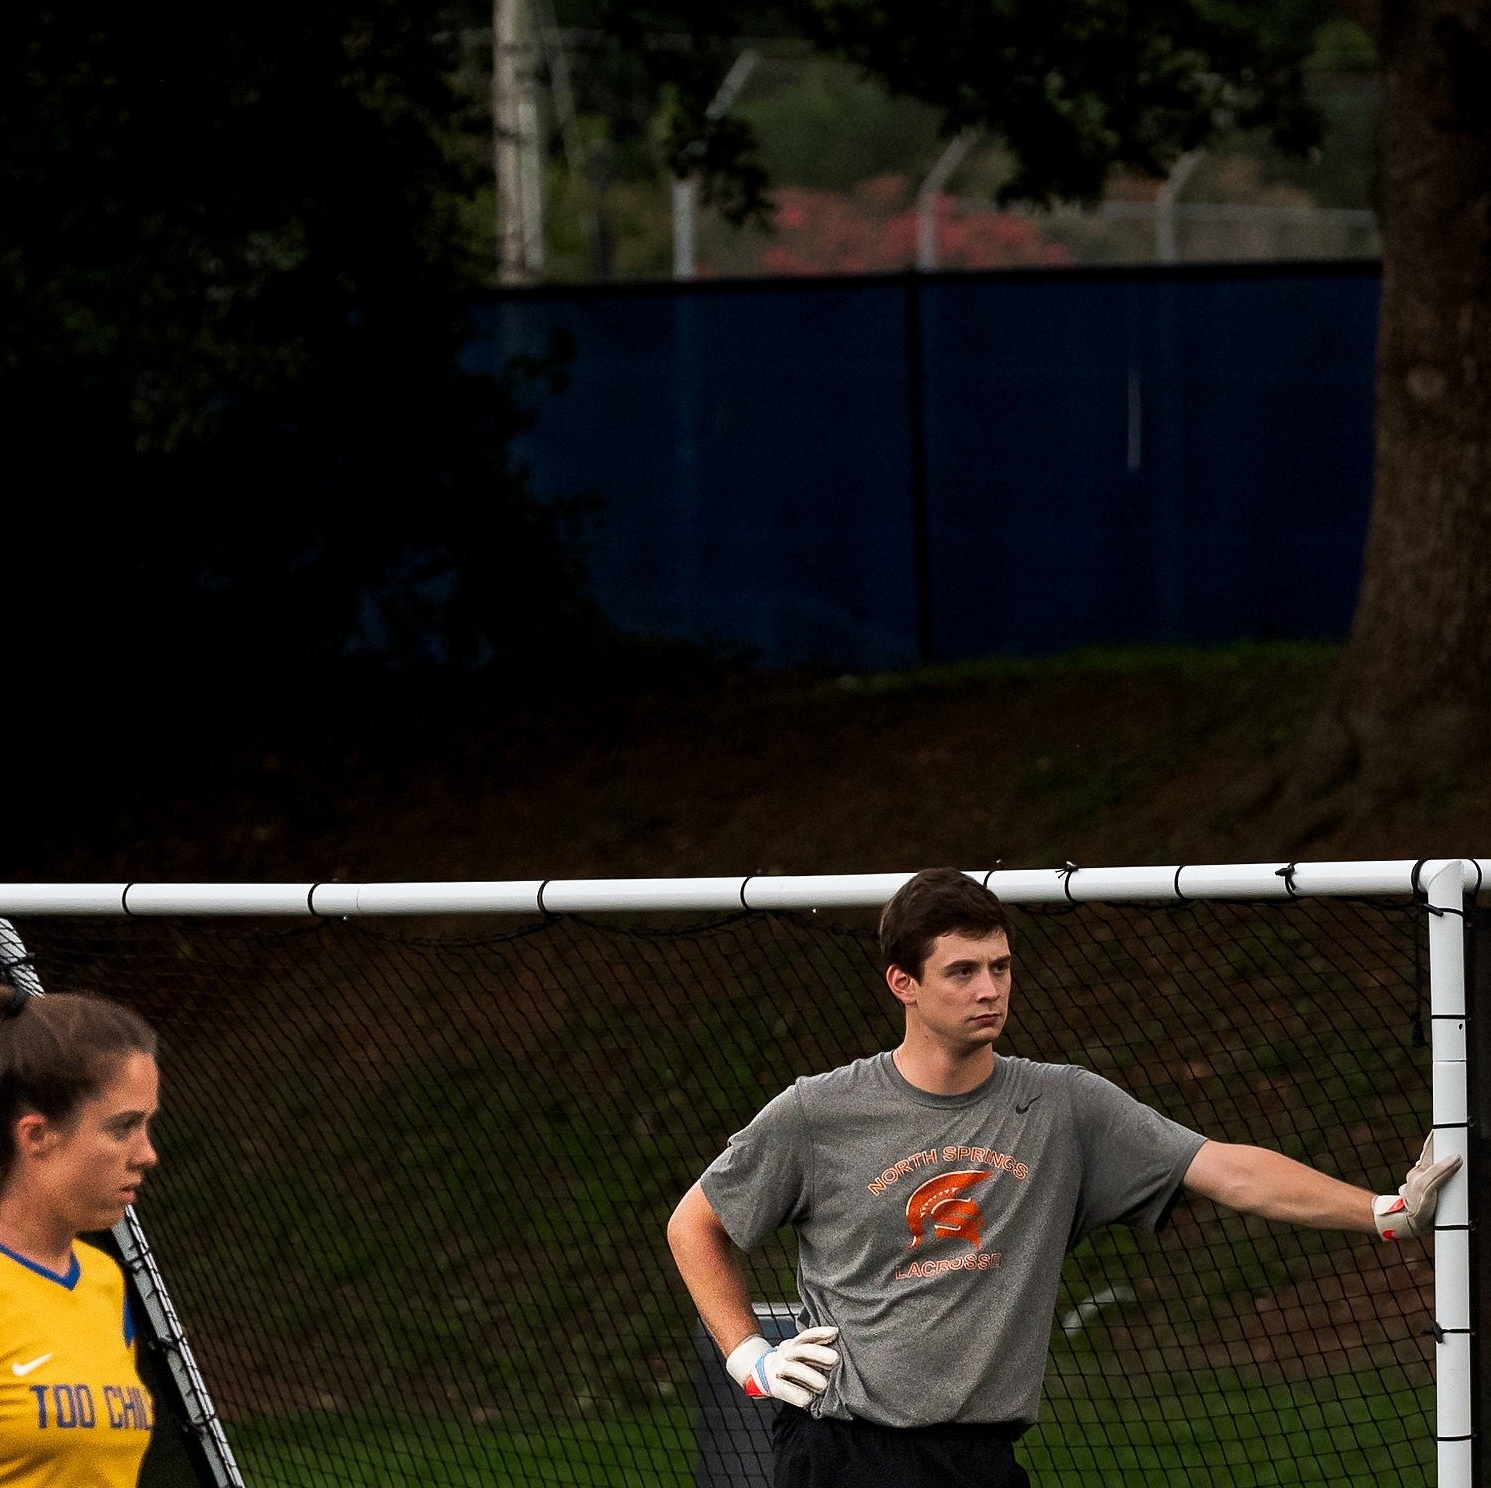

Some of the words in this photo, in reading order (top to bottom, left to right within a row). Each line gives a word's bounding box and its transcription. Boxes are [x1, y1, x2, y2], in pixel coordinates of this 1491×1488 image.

[867, 1149, 938, 1196] NORTH
[942, 1146, 1028, 1180] SPRINGS
[895, 1253, 1001, 1280] LACROSSE
[29, 1383, 96, 1429] TOO
